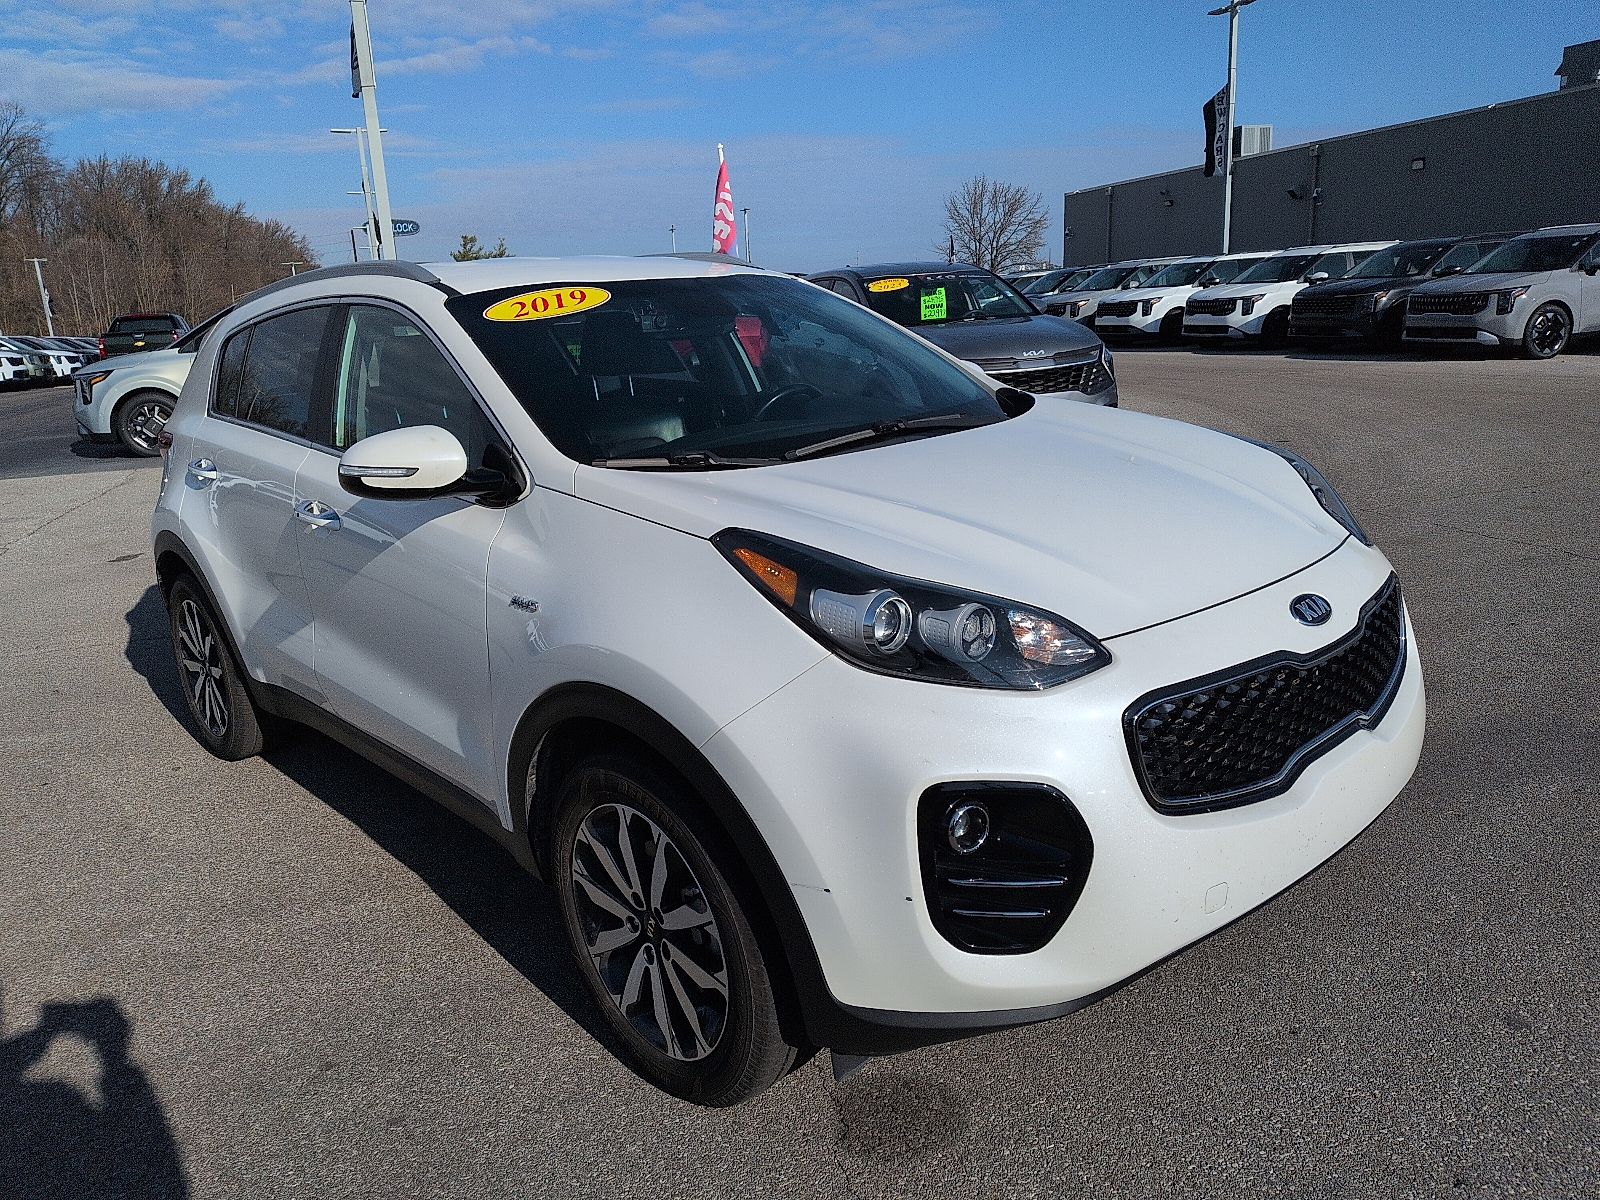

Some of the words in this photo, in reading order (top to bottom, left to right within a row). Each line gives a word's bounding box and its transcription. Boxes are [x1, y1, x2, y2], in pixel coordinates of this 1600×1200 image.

[391, 223, 414, 233] LOCK
[510, 290, 587, 318] 2019
[1295, 594, 1330, 621] KIA
[646, 916, 656, 938] KIA
